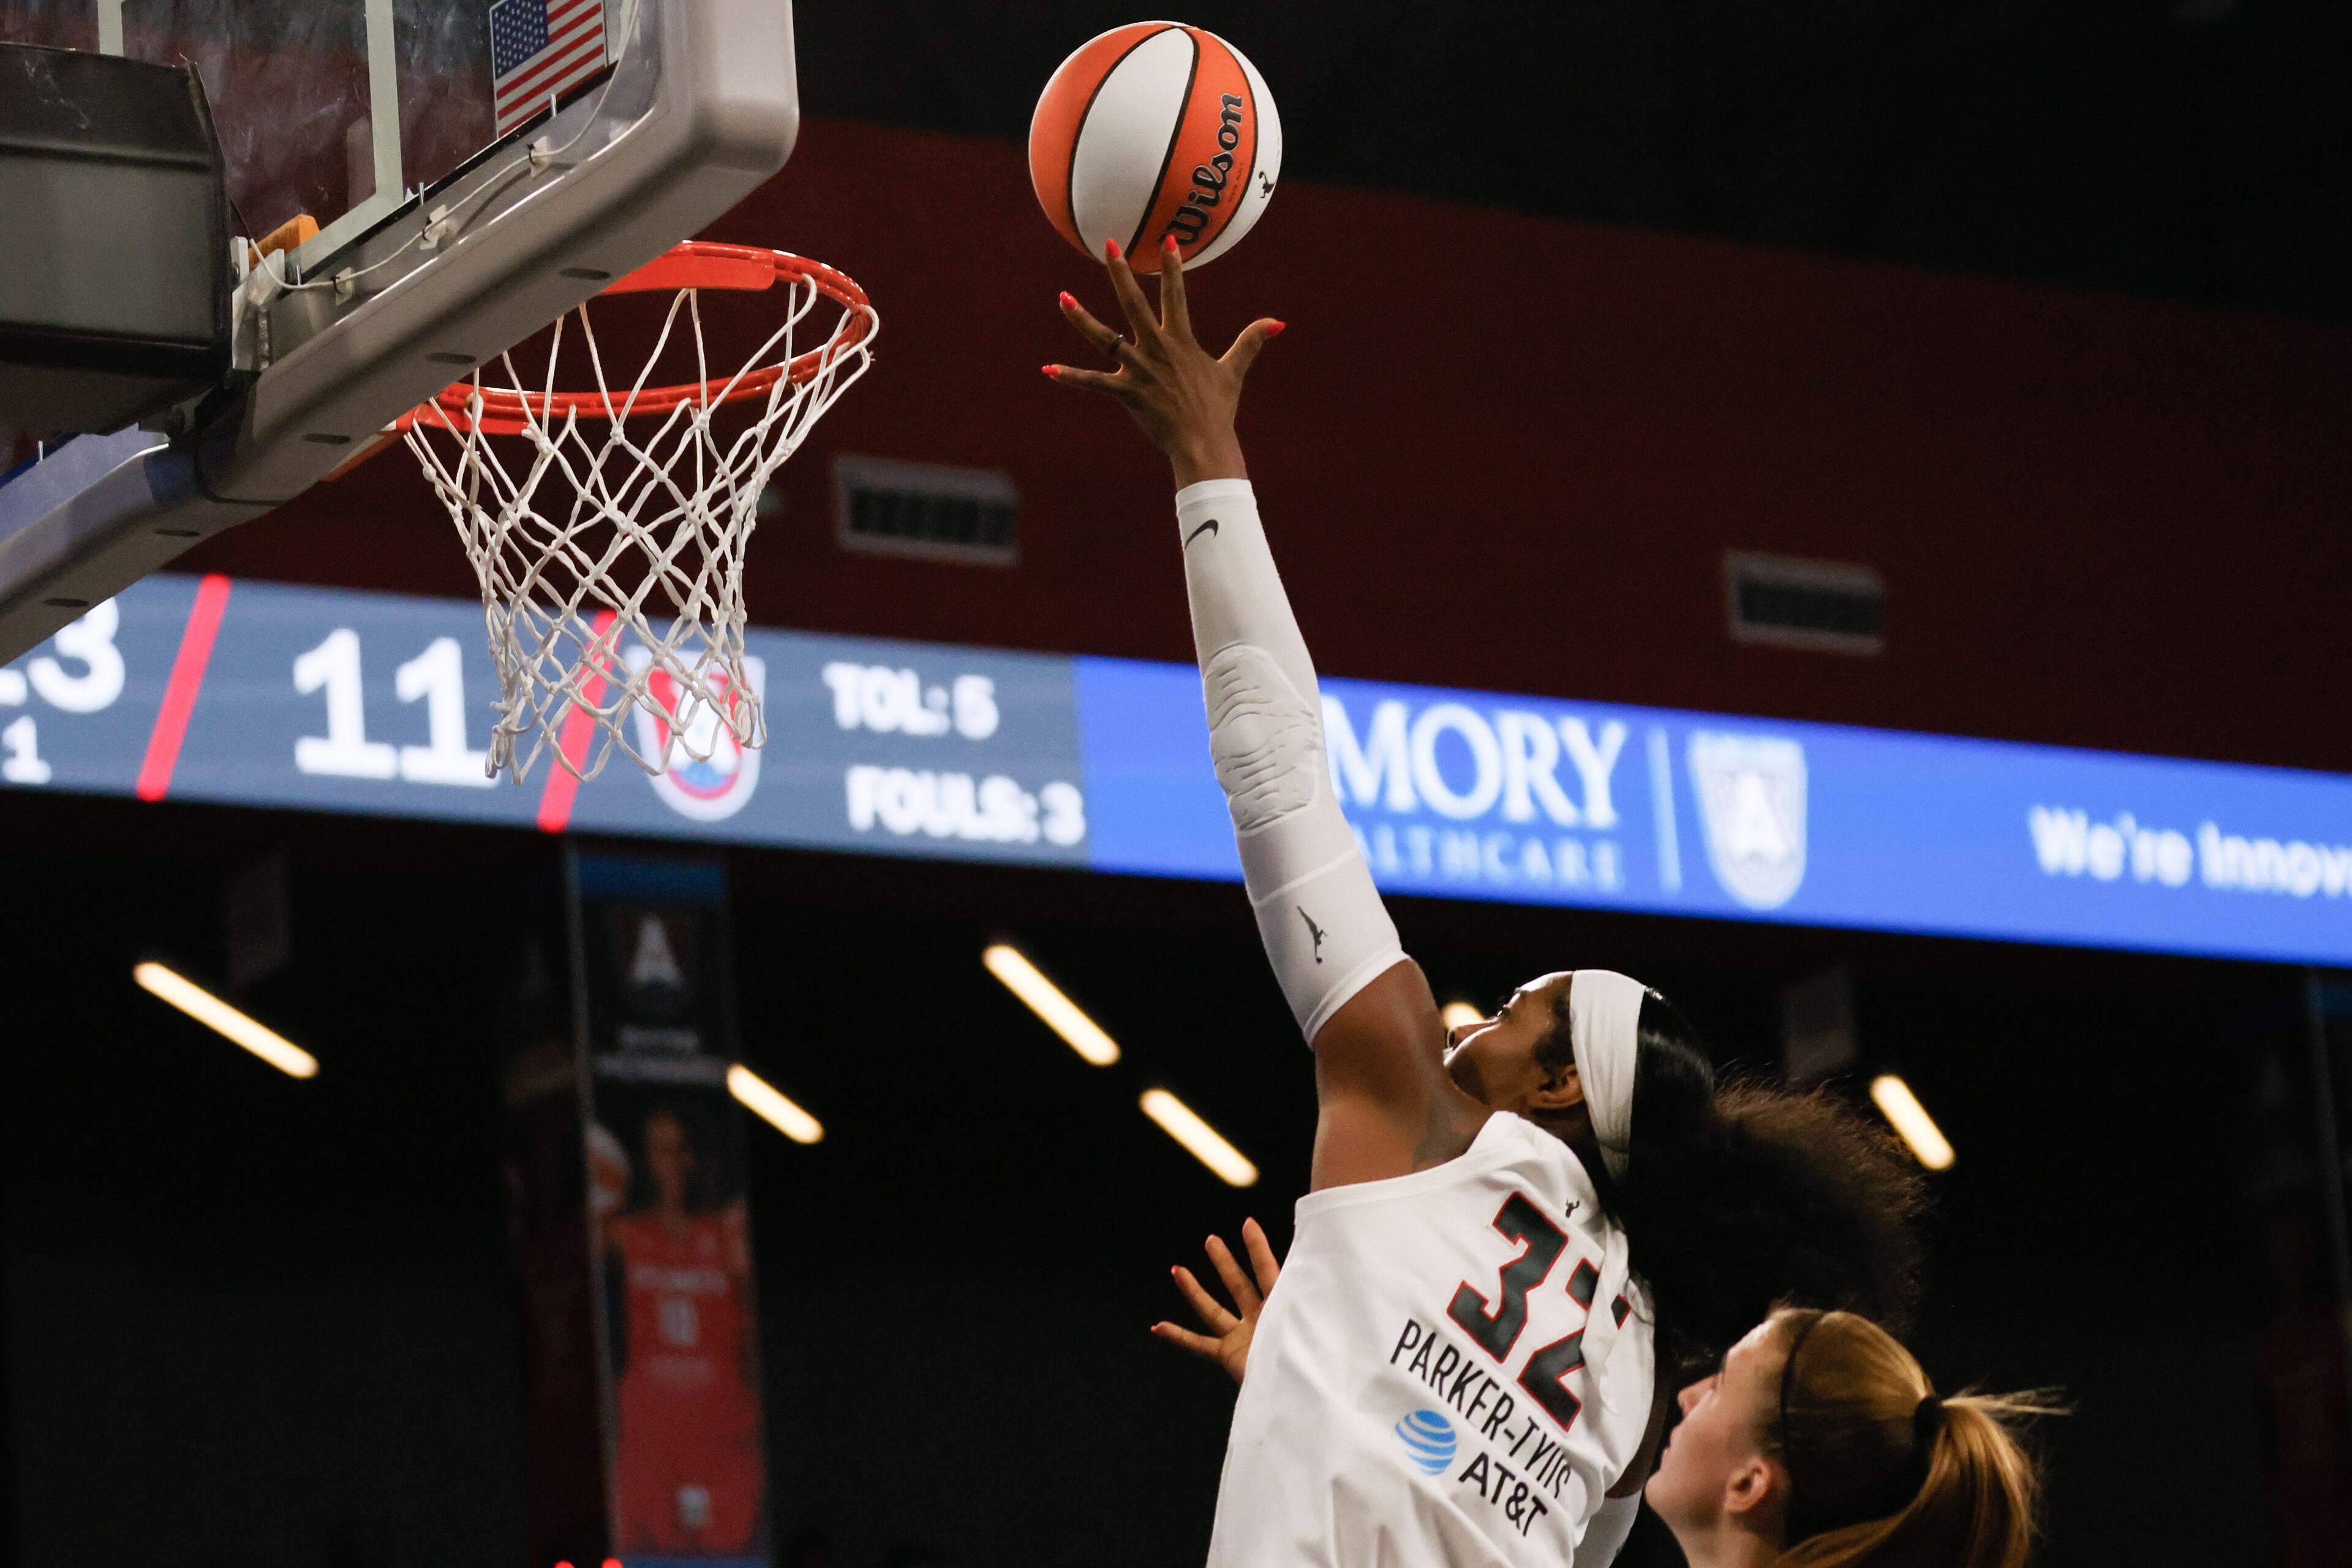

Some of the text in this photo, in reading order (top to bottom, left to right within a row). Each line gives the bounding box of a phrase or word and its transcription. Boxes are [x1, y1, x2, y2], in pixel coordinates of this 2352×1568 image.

[1159, 92, 1243, 246] Wilson
[293, 628, 501, 787] 11
[823, 662, 949, 735] TOL:
[1, 715, 52, 784] 1
[1320, 695, 1629, 829] MORY
[847, 764, 1039, 843] FOULS:
[2027, 804, 2352, 899] We're Innov
[1447, 1191, 1630, 1432] 32
[1458, 1452, 1548, 1537] AT&T
